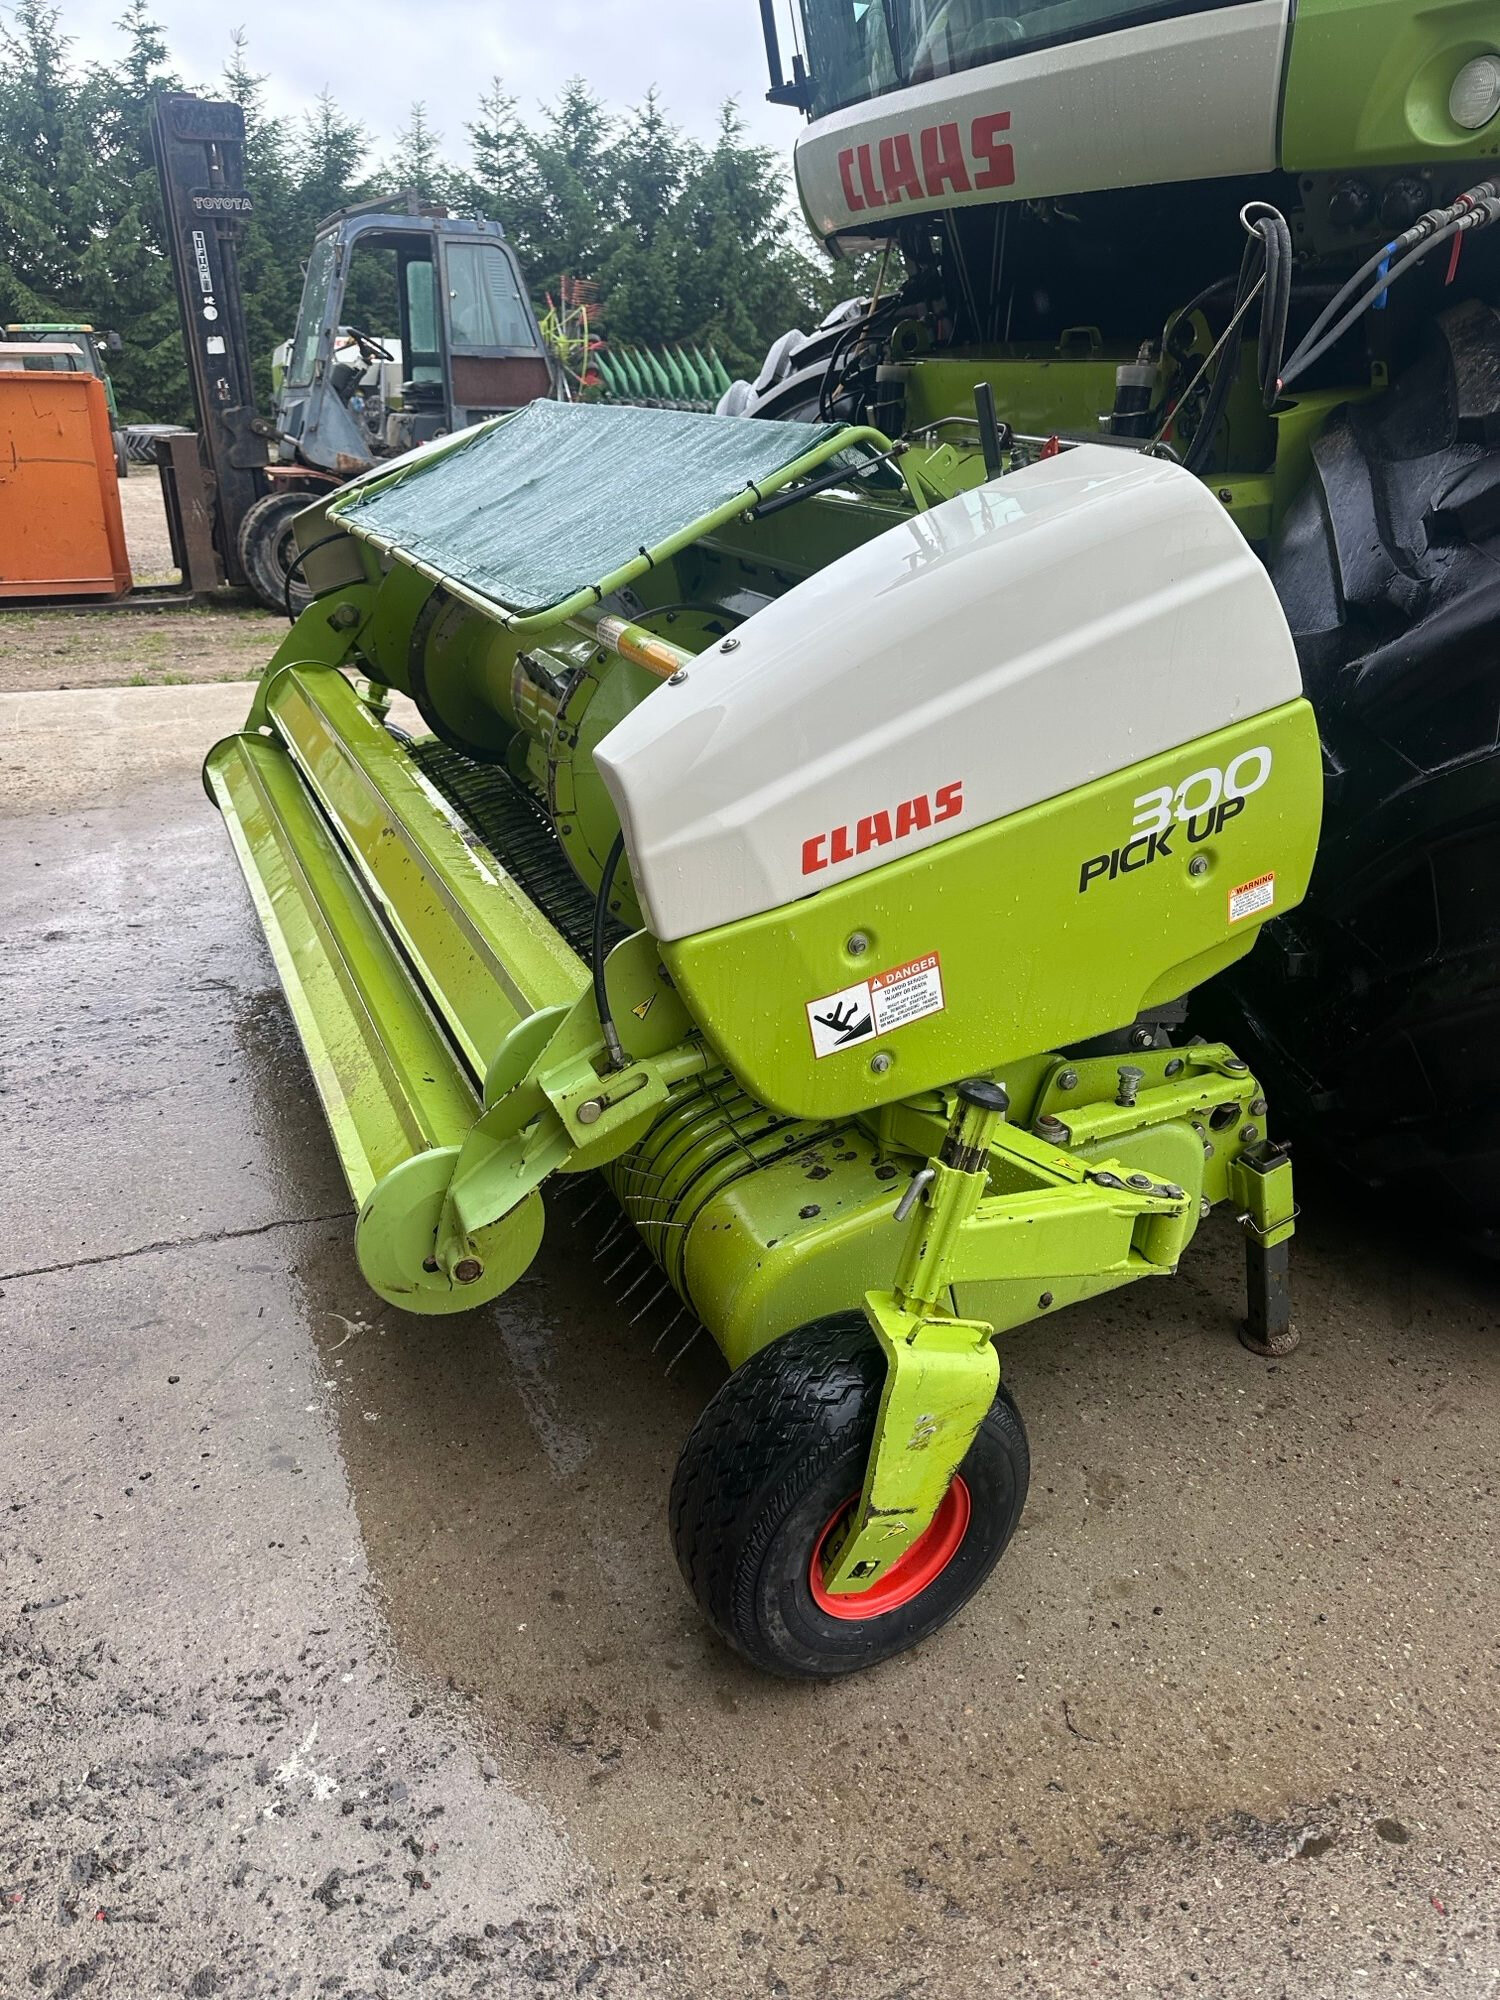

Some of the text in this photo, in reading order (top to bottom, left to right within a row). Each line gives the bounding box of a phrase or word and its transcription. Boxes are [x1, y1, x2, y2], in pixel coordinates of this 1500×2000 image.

[838, 111, 1015, 212] CLAAS
[193, 197, 253, 210] TOYOTA
[1130, 746, 1272, 843] 300
[802, 781, 963, 876] CLAAS
[1079, 796, 1245, 893] PICK UP
[1236, 873, 1273, 894] WARNING
[886, 957, 937, 984] DANGER
[891, 983, 906, 992] AVOID
[907, 974, 928, 986] SERIOUS
[885, 991, 902, 1002] INJURY
[911, 981, 926, 991] DEATH
